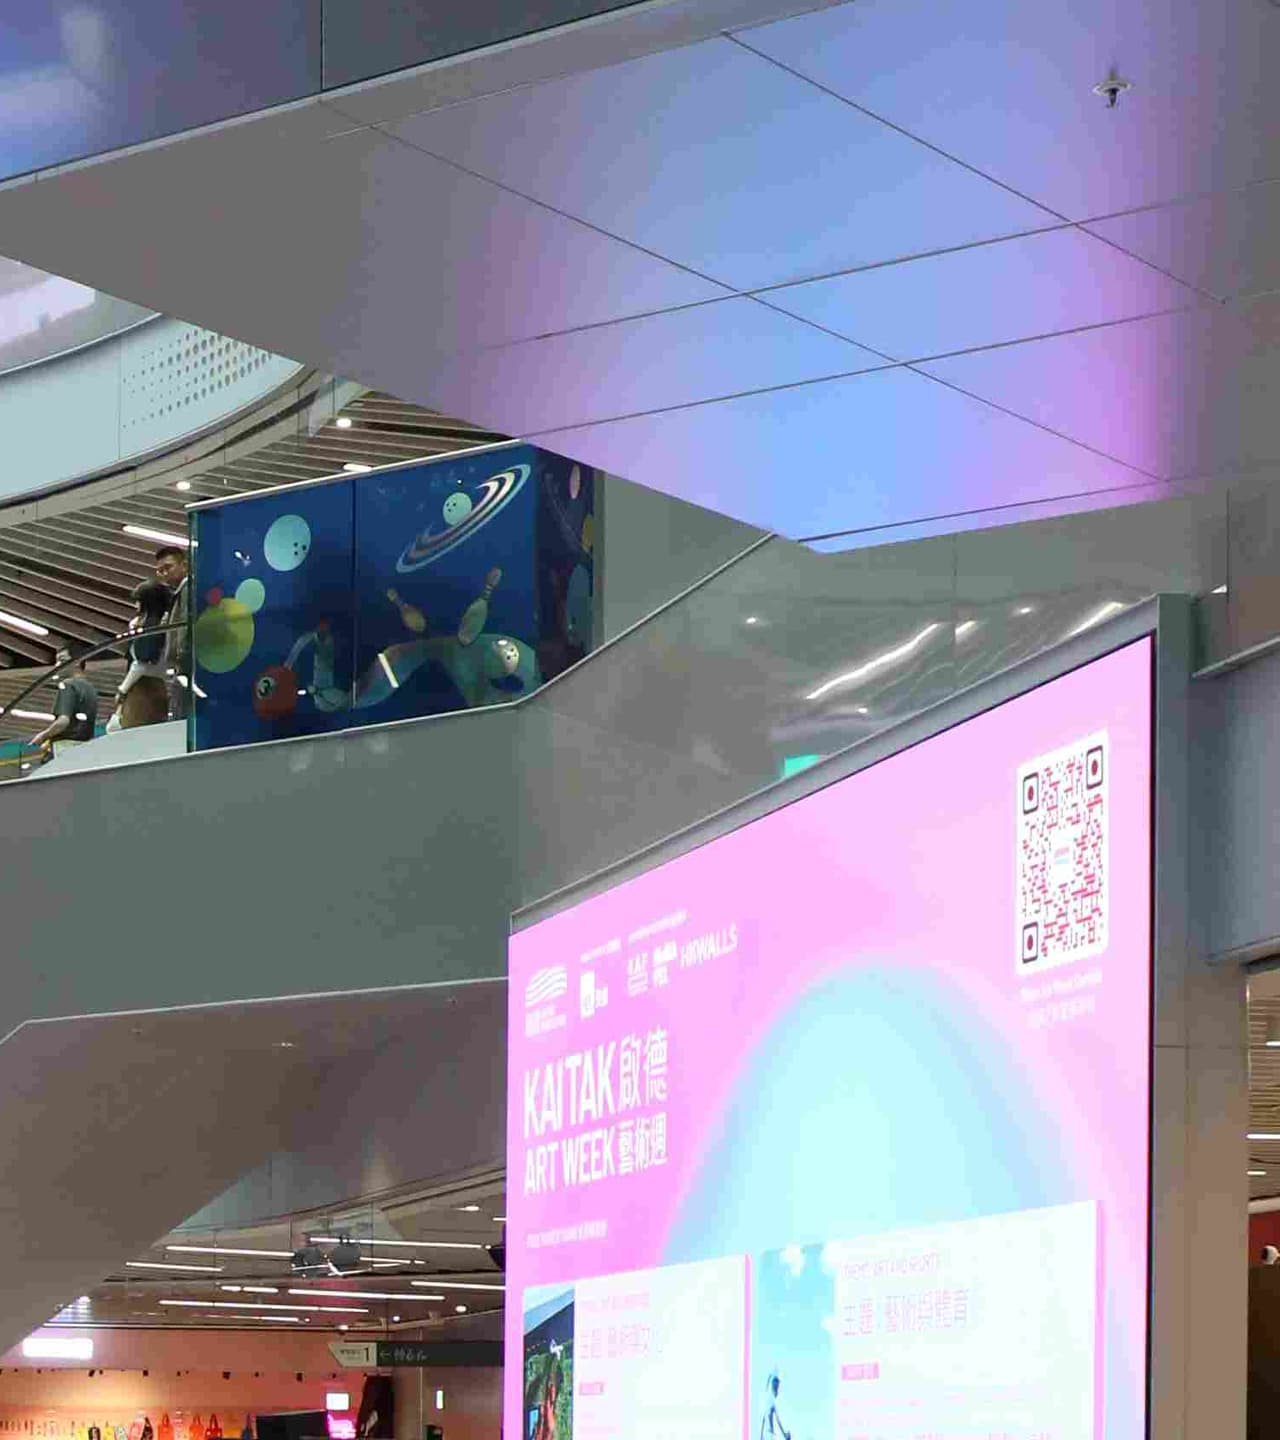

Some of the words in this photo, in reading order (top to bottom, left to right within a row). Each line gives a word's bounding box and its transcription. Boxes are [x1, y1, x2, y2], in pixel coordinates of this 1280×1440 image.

[524, 1059, 564, 1140] KAI
[565, 1041, 617, 1128] TAK
[525, 1142, 560, 1196] ART
[561, 1125, 616, 1188] WEEK
